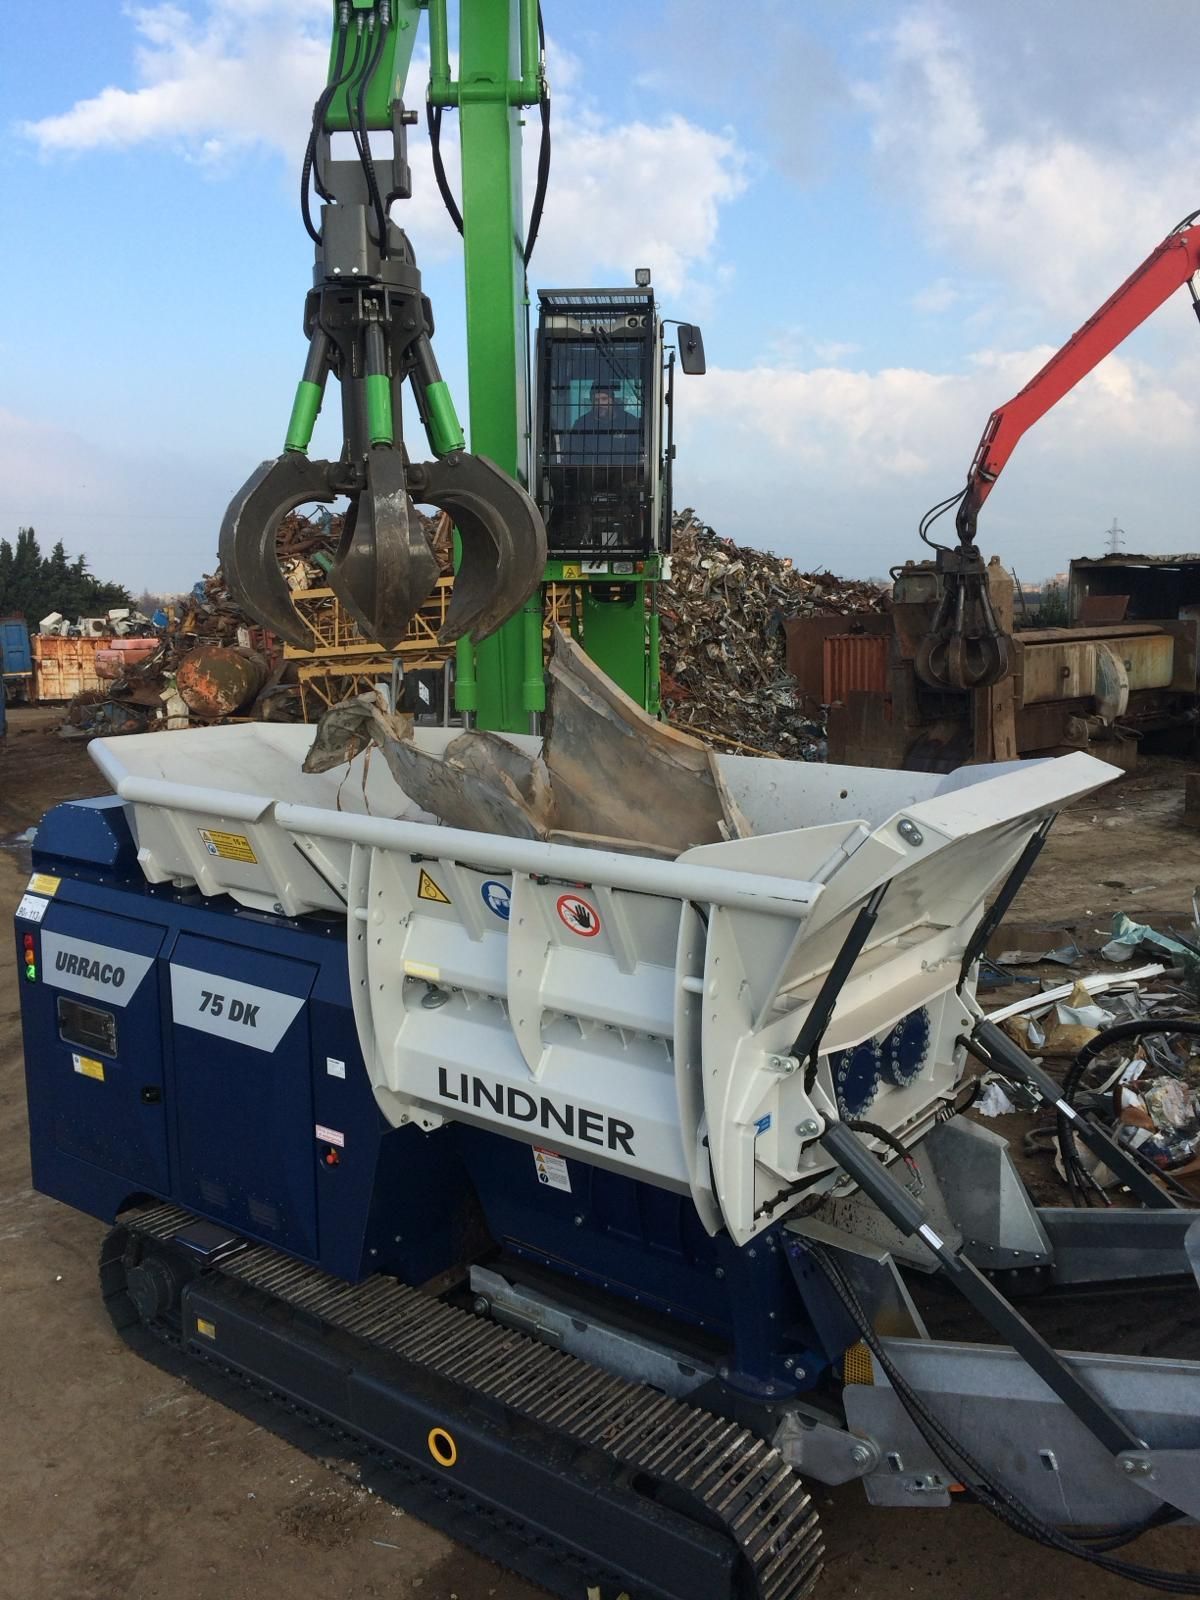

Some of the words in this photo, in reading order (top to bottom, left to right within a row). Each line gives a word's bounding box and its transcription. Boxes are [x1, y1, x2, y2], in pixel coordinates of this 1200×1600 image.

[55, 951, 125, 987] URRACO
[198, 990, 225, 1016] 75
[227, 999, 261, 1028] DK
[438, 1066, 636, 1157] LINDNER
